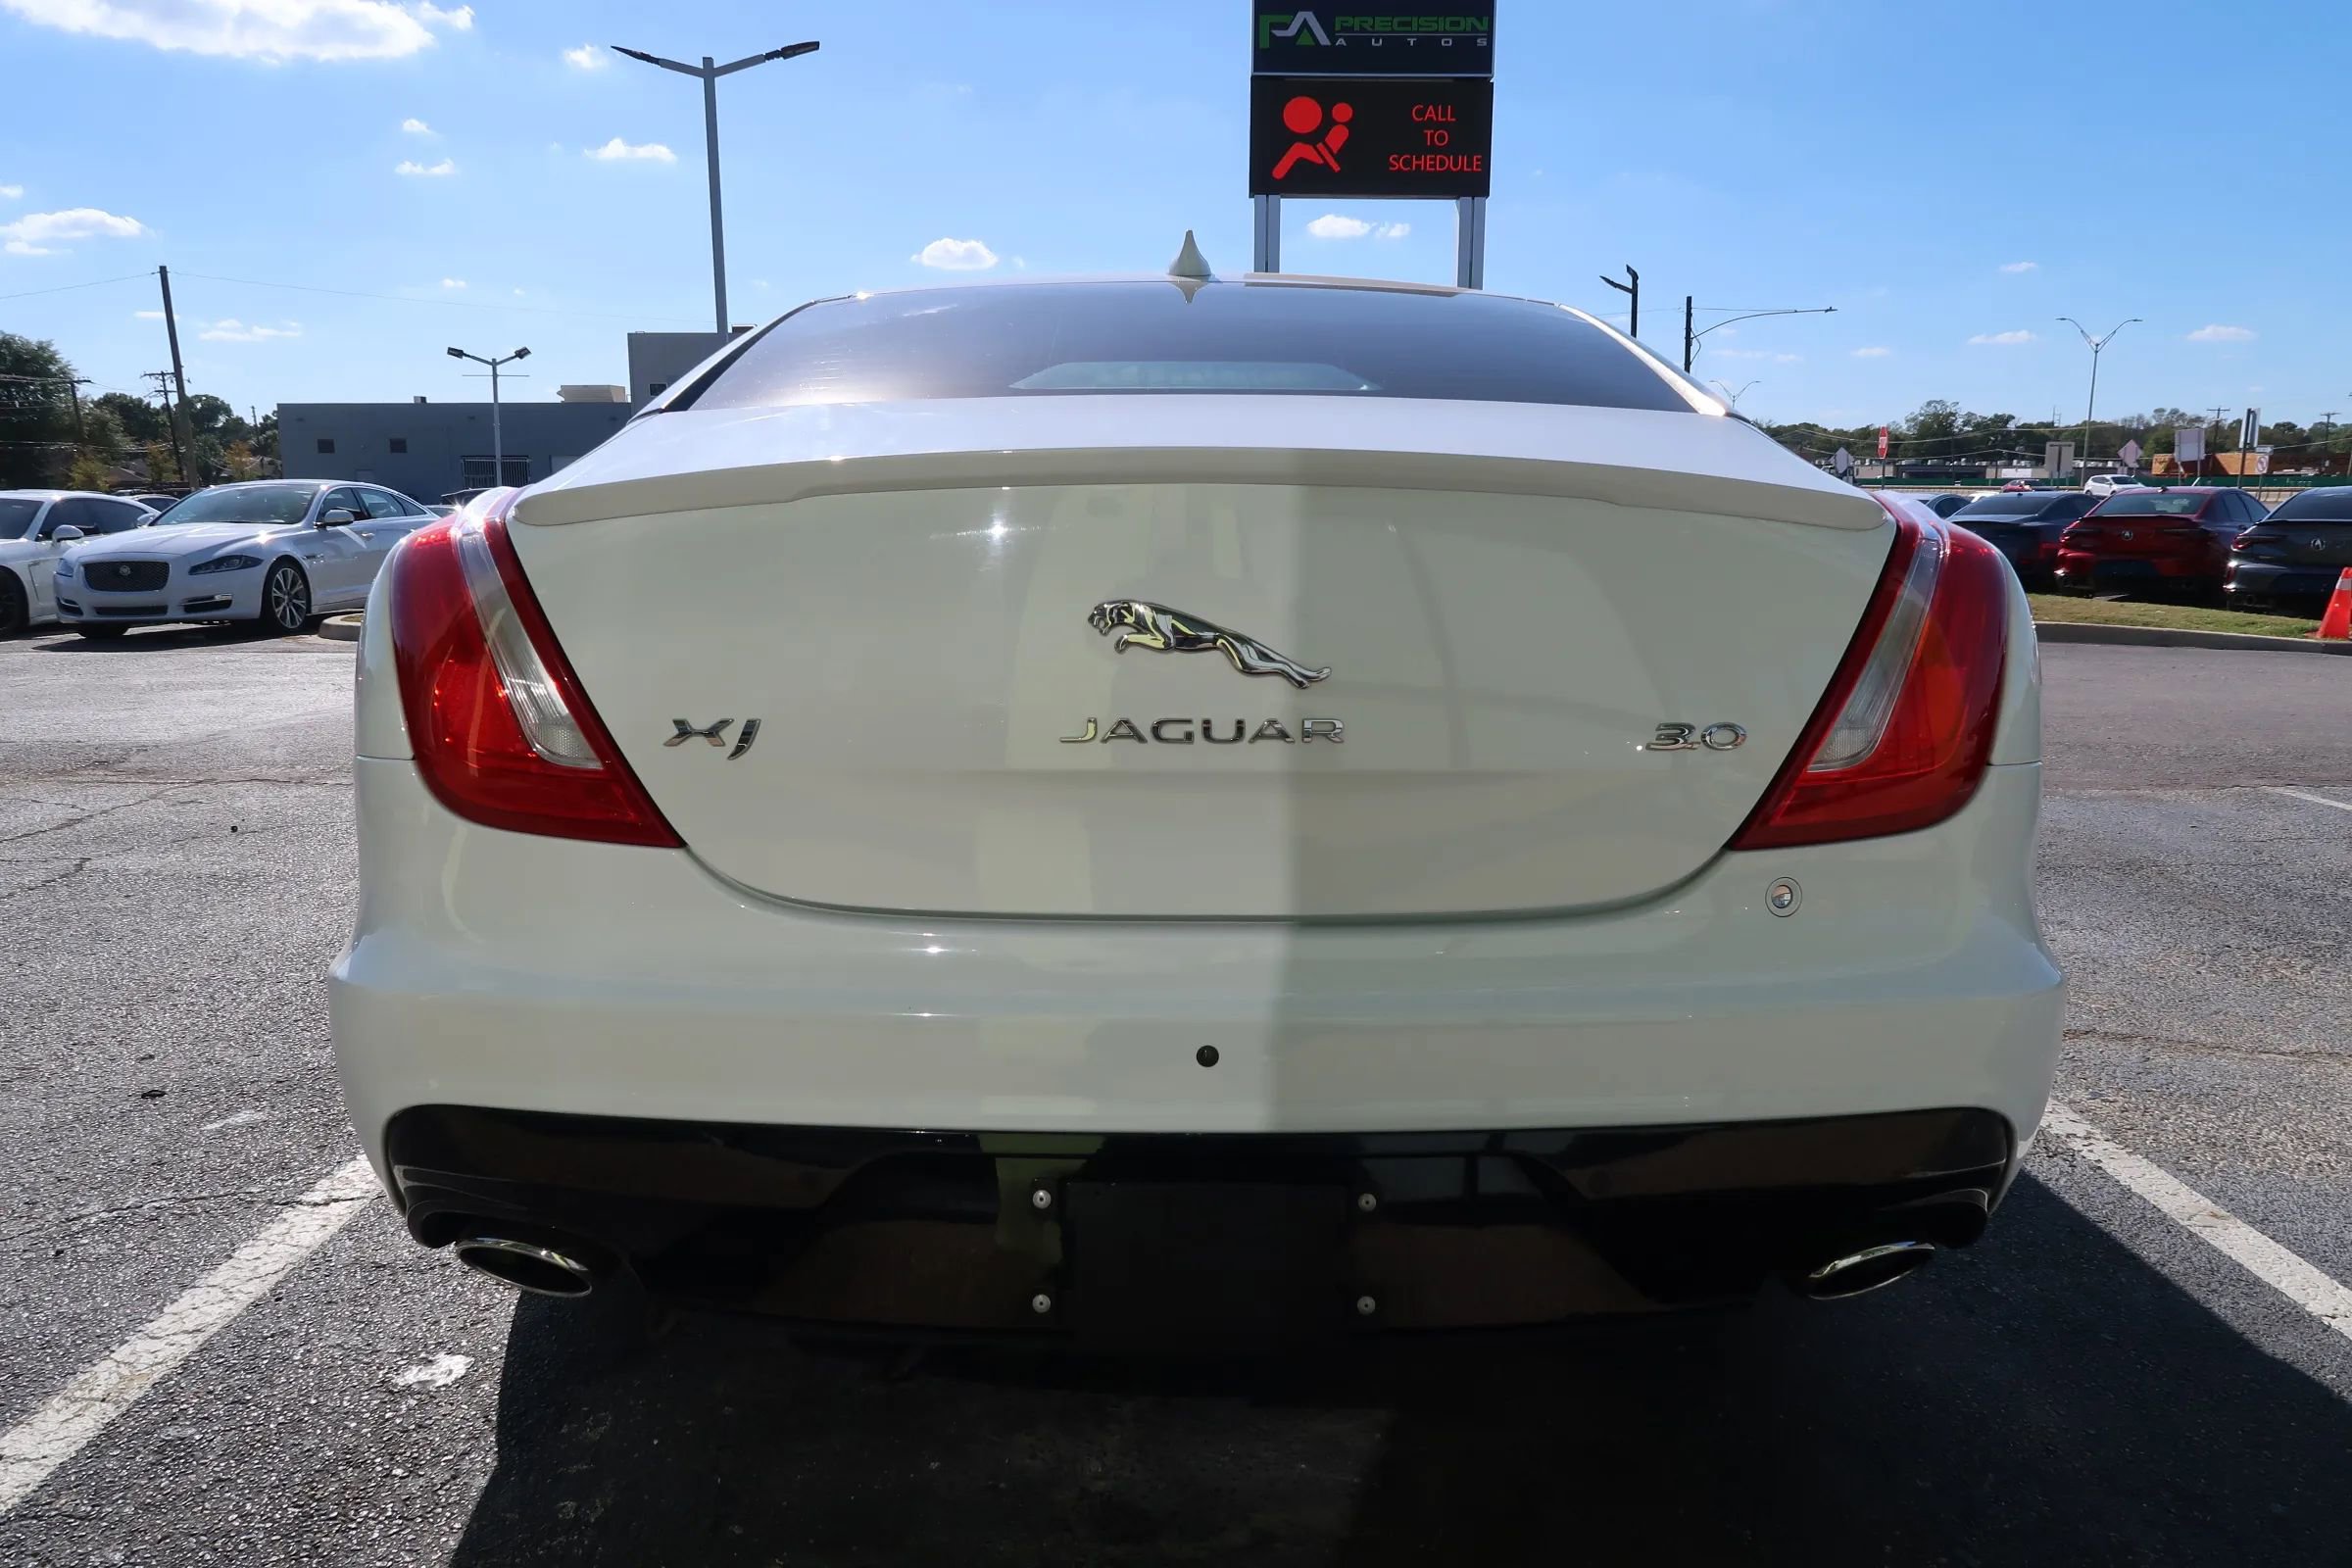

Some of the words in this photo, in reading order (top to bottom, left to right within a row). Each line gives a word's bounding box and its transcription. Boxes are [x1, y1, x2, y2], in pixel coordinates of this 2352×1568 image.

[1335, 16, 1490, 31] PRECISION
[1335, 37, 1488, 47] AUTOS
[1411, 104, 1456, 122] CALL
[1424, 129, 1449, 146] TO
[1389, 155, 1483, 172] SCHEDULE
[662, 718, 761, 760] XJ
[1059, 717, 1345, 745] JAGUAR
